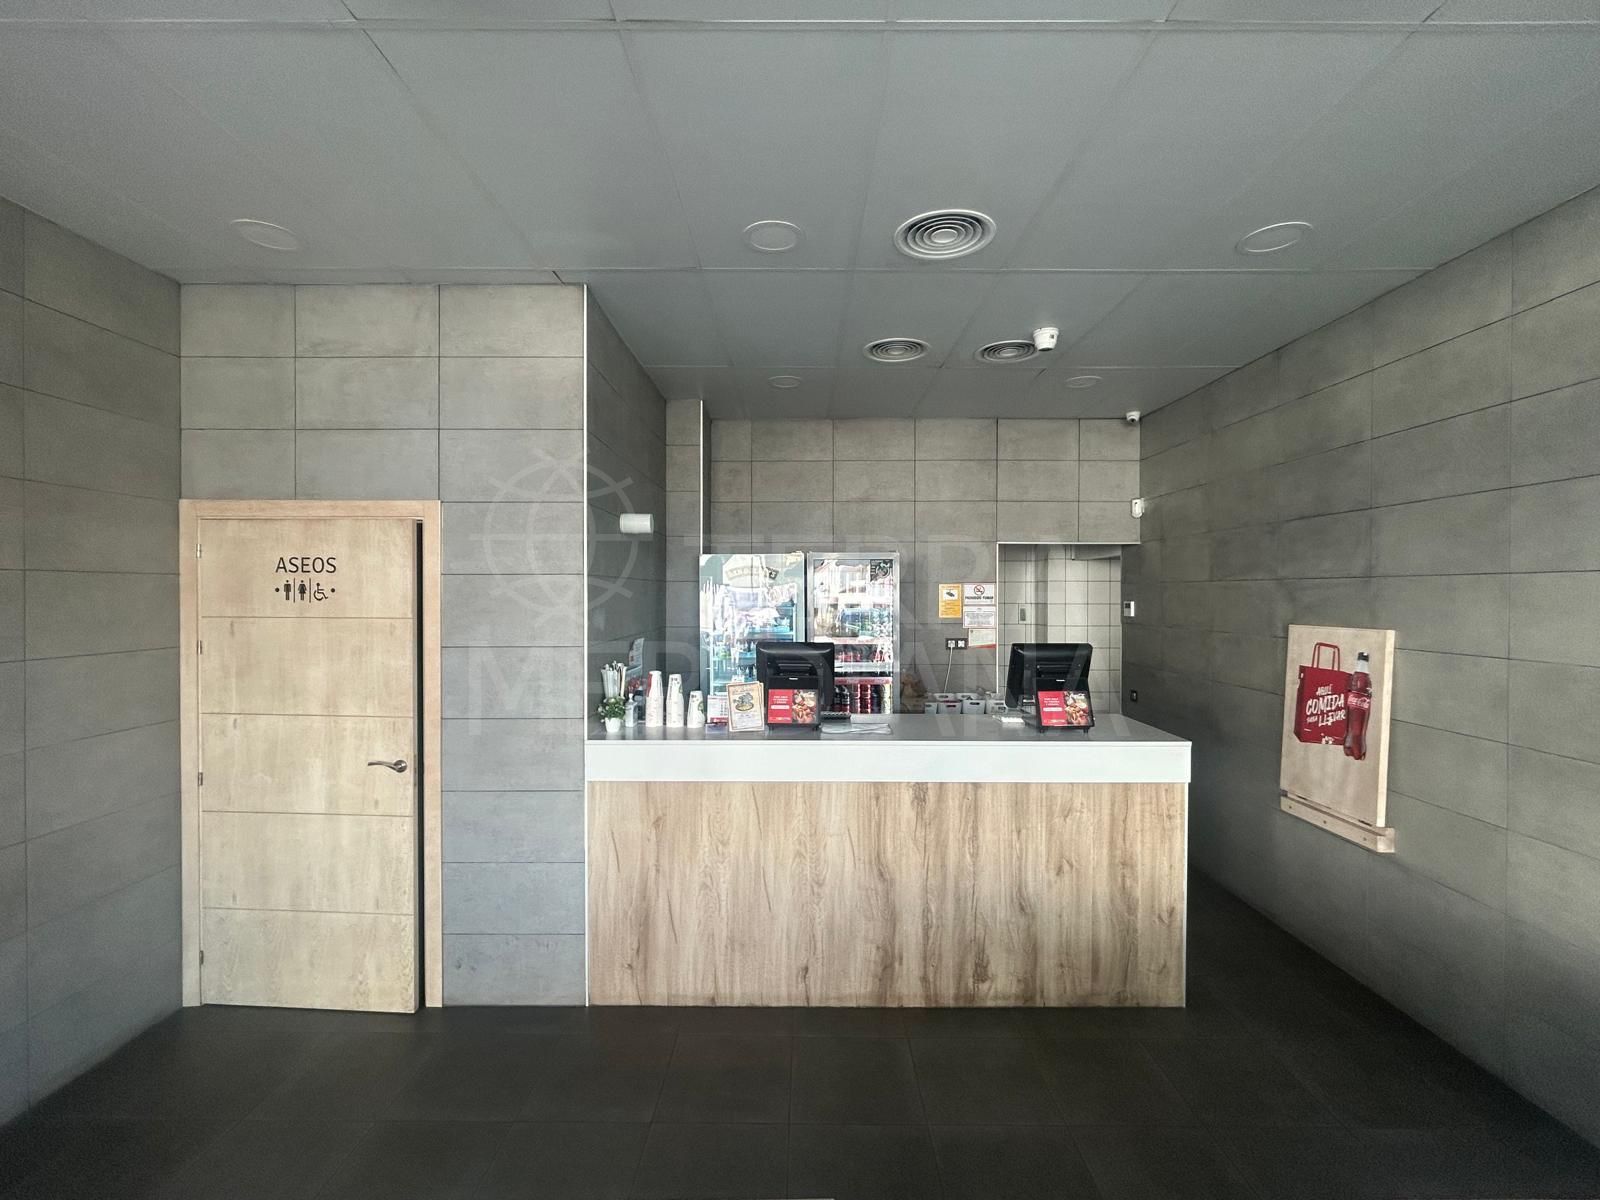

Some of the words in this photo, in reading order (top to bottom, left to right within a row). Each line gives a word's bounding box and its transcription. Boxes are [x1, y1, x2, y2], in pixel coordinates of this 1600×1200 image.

[275, 556, 337, 574] ASEOS
[1306, 694, 1345, 715] COMIDA
[1318, 709, 1346, 727] LLEVAR
